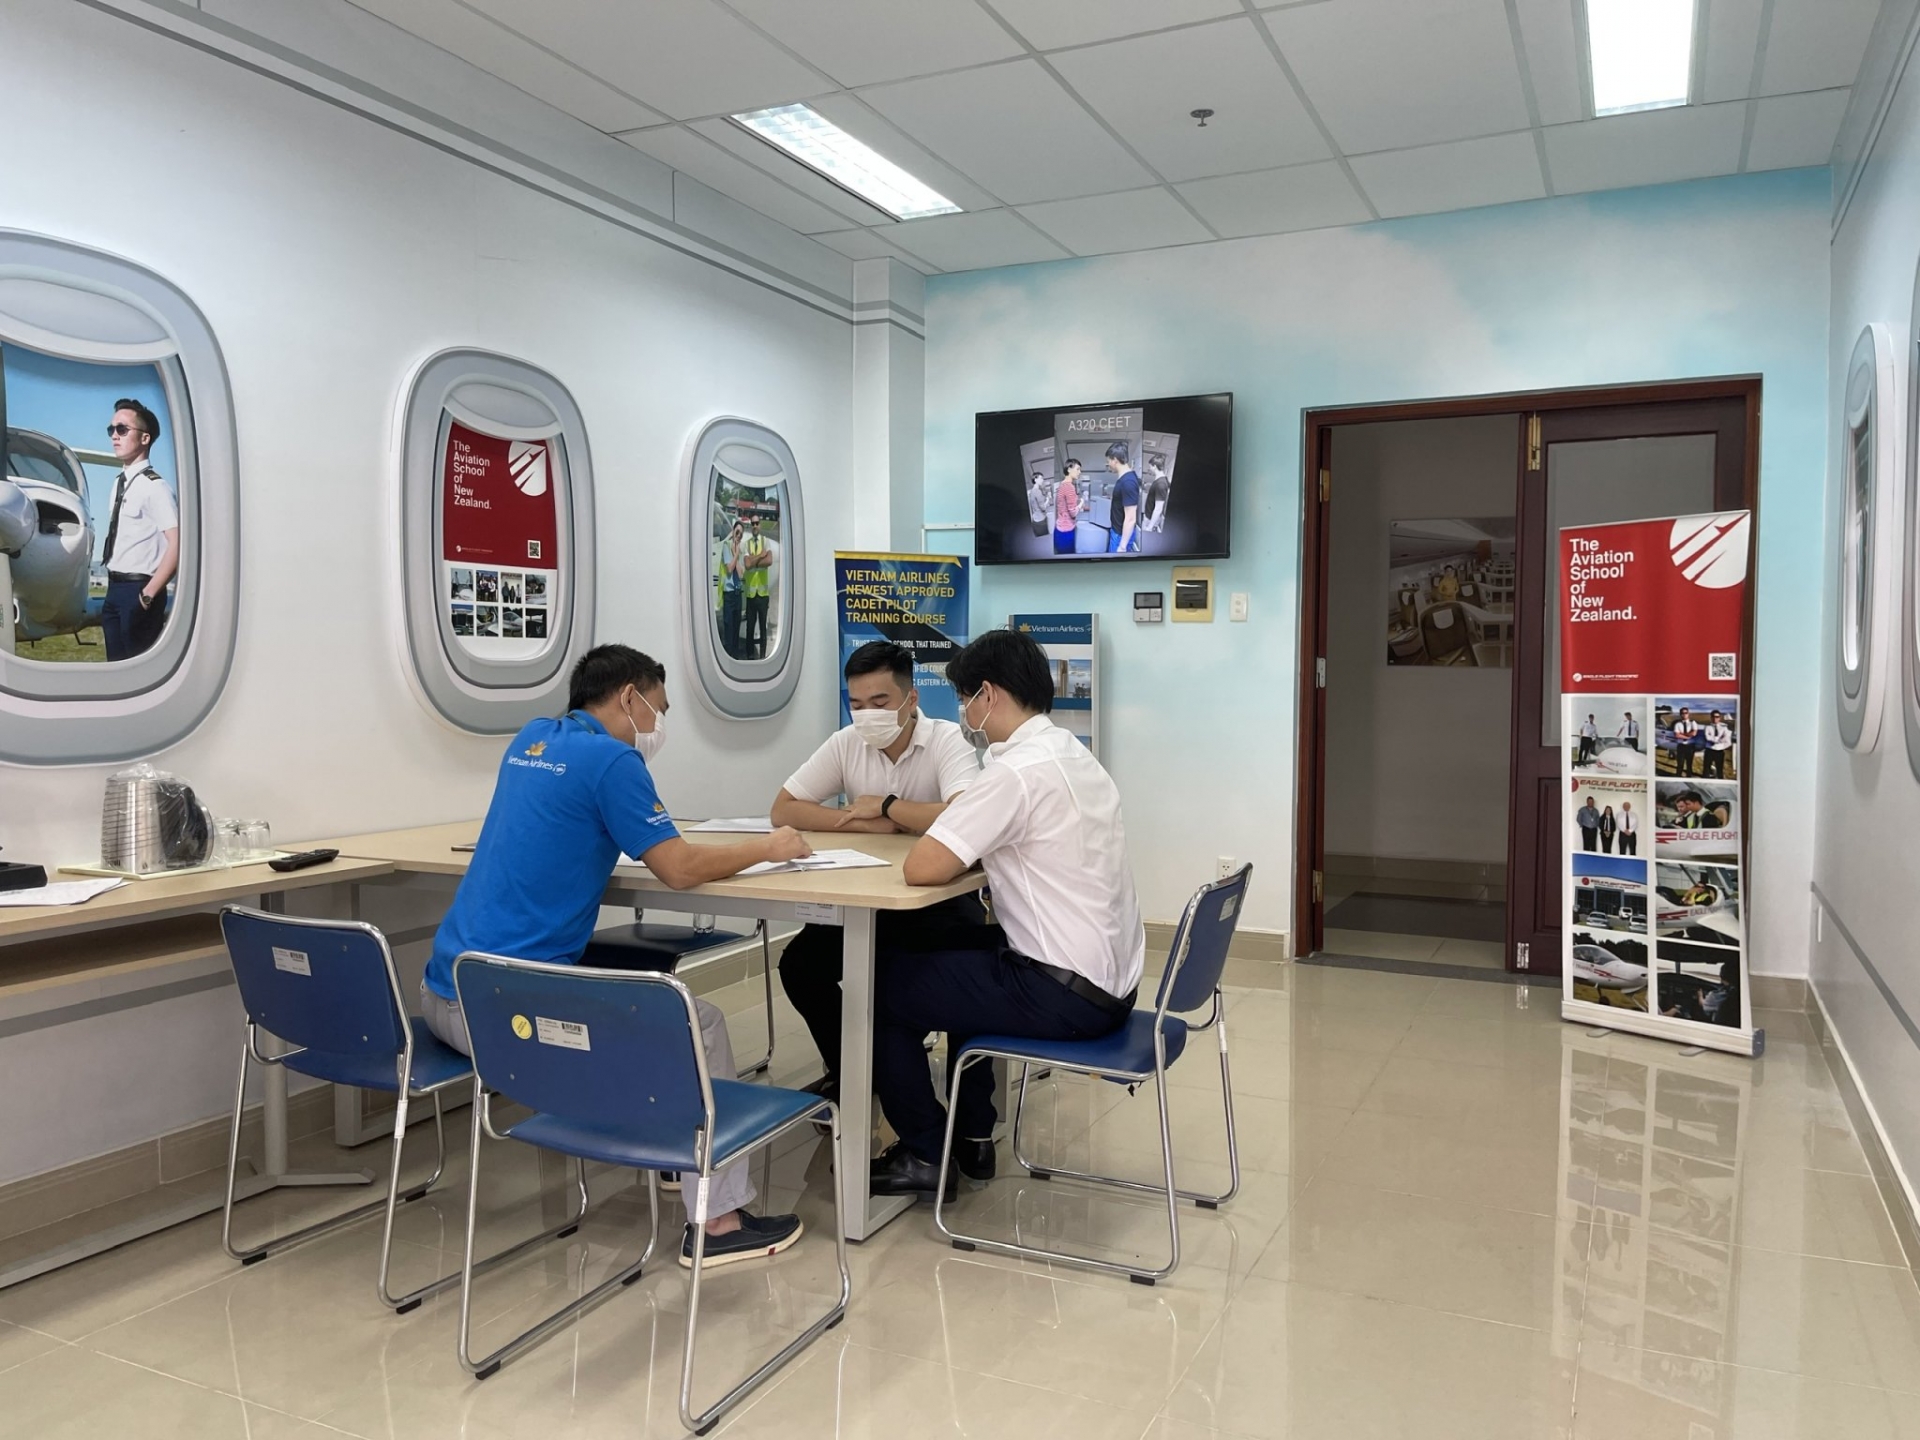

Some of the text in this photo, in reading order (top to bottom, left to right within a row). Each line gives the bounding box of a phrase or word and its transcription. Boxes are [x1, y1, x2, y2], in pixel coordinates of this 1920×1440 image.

[1068, 416, 1131, 431] A320 CEET
[453, 440, 470, 453] The
[453, 451, 490, 467] Aviation
[453, 463, 485, 477] School
[454, 473, 463, 484] of
[454, 484, 474, 497] New
[454, 496, 492, 509] Zealand.
[1570, 538, 1599, 552] The
[1570, 551, 1634, 566] Aviation
[845, 569, 950, 583] VIETNAM AIRLINES
[1570, 564, 1624, 580] School
[846, 585, 955, 598] NEWEST APPROVED
[1570, 581, 1586, 595] of
[846, 598, 917, 610] CADET PILOT
[1570, 595, 1604, 608] New
[846, 612, 946, 624] TRAINING COURSE
[1570, 606, 1637, 622] Zealand.
[916, 640, 928, 648] THAT
[930, 640, 952, 649] TRAINED
[1580, 779, 1607, 787] EAGLE
[1679, 832, 1709, 840] EAGLE
